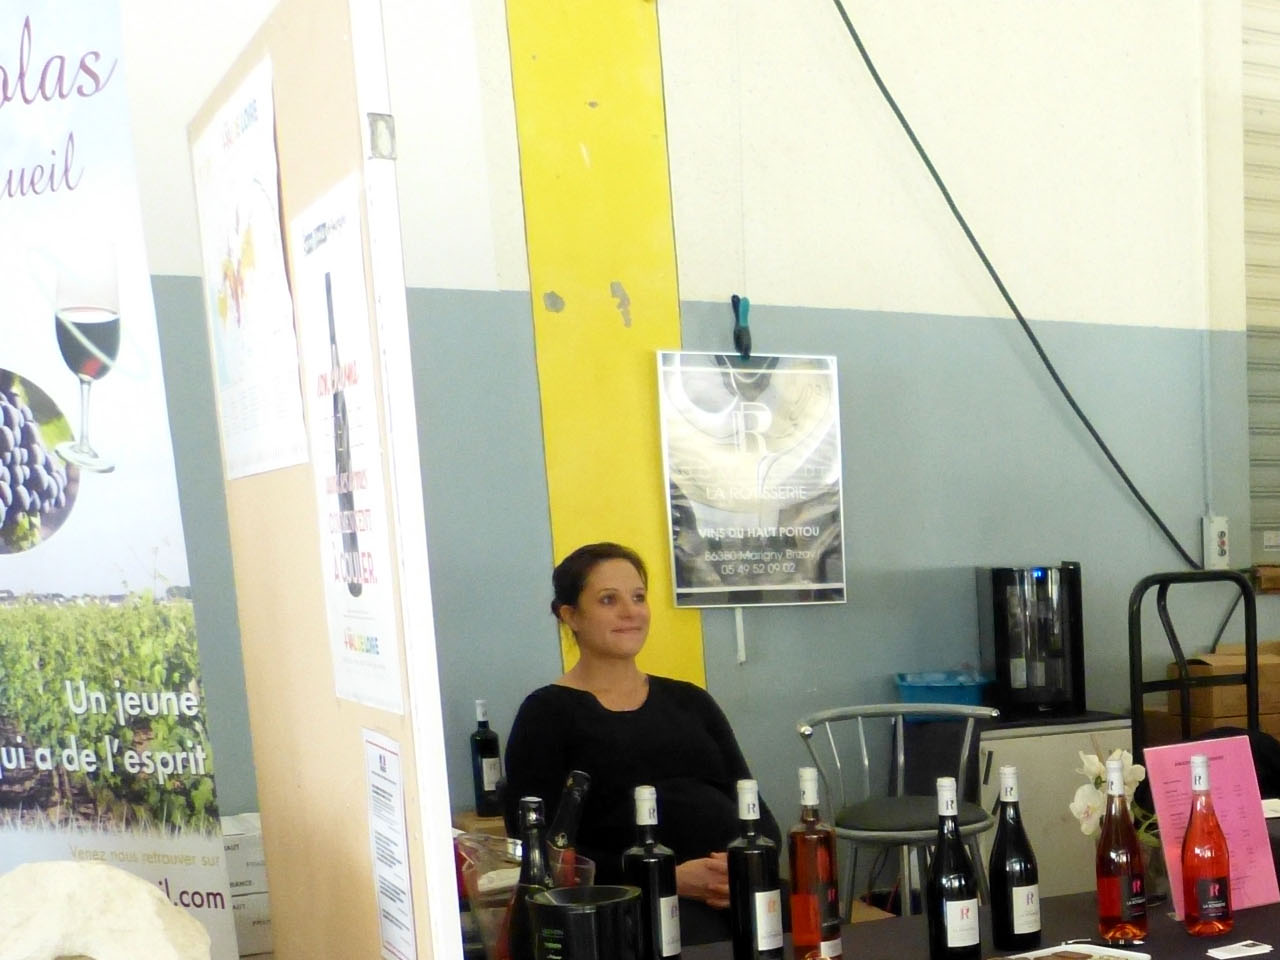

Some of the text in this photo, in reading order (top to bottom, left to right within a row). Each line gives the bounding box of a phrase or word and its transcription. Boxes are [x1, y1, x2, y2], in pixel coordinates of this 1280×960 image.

[706, 487, 725, 500] LA
[699, 526, 820, 541] VINS DU HAUT POITOU
[721, 562, 796, 575] 05 49 52 09 02
[65, 680, 200, 726] Un jeune
[34, 747, 53, 770] a
[61, 734, 98, 773] de
[70, 847, 220, 867] Venez nous retrouver sur
